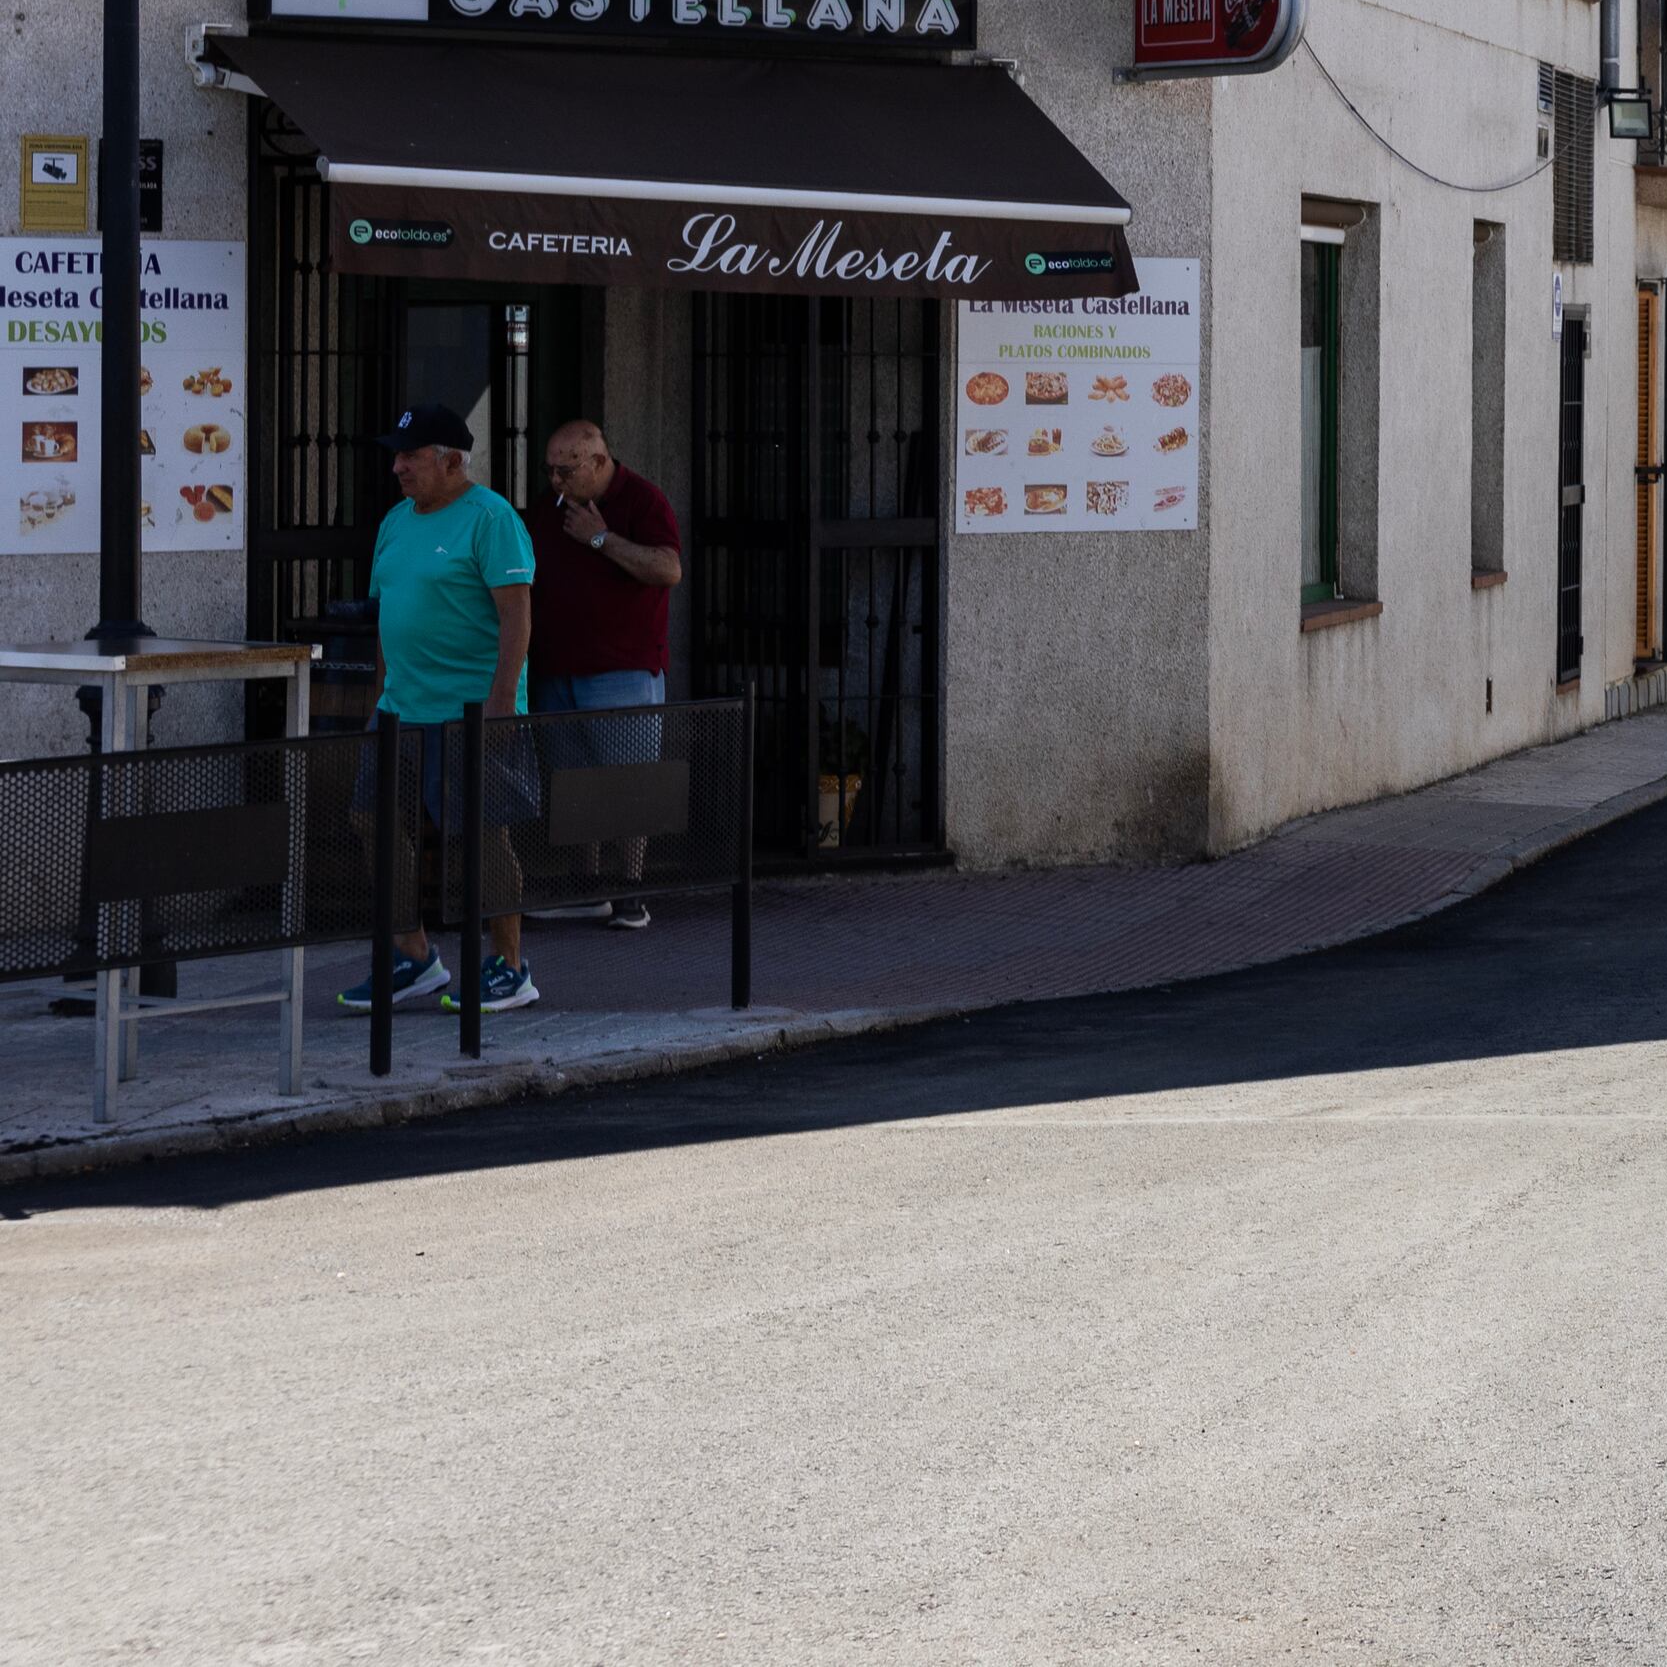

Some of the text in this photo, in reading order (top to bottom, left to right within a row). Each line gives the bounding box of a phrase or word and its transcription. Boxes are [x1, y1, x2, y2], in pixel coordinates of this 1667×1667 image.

[488, 231, 632, 257] CAFETERIA
[667, 213, 992, 284] La Meseta
[0, 286, 229, 310] eseta Ctellana
[969, 299, 993, 313] La
[1082, 296, 1190, 315] Castellana
[1033, 325, 1117, 339] RACIONES Y
[1000, 345, 1151, 359] PLATOS COMBINADOS
